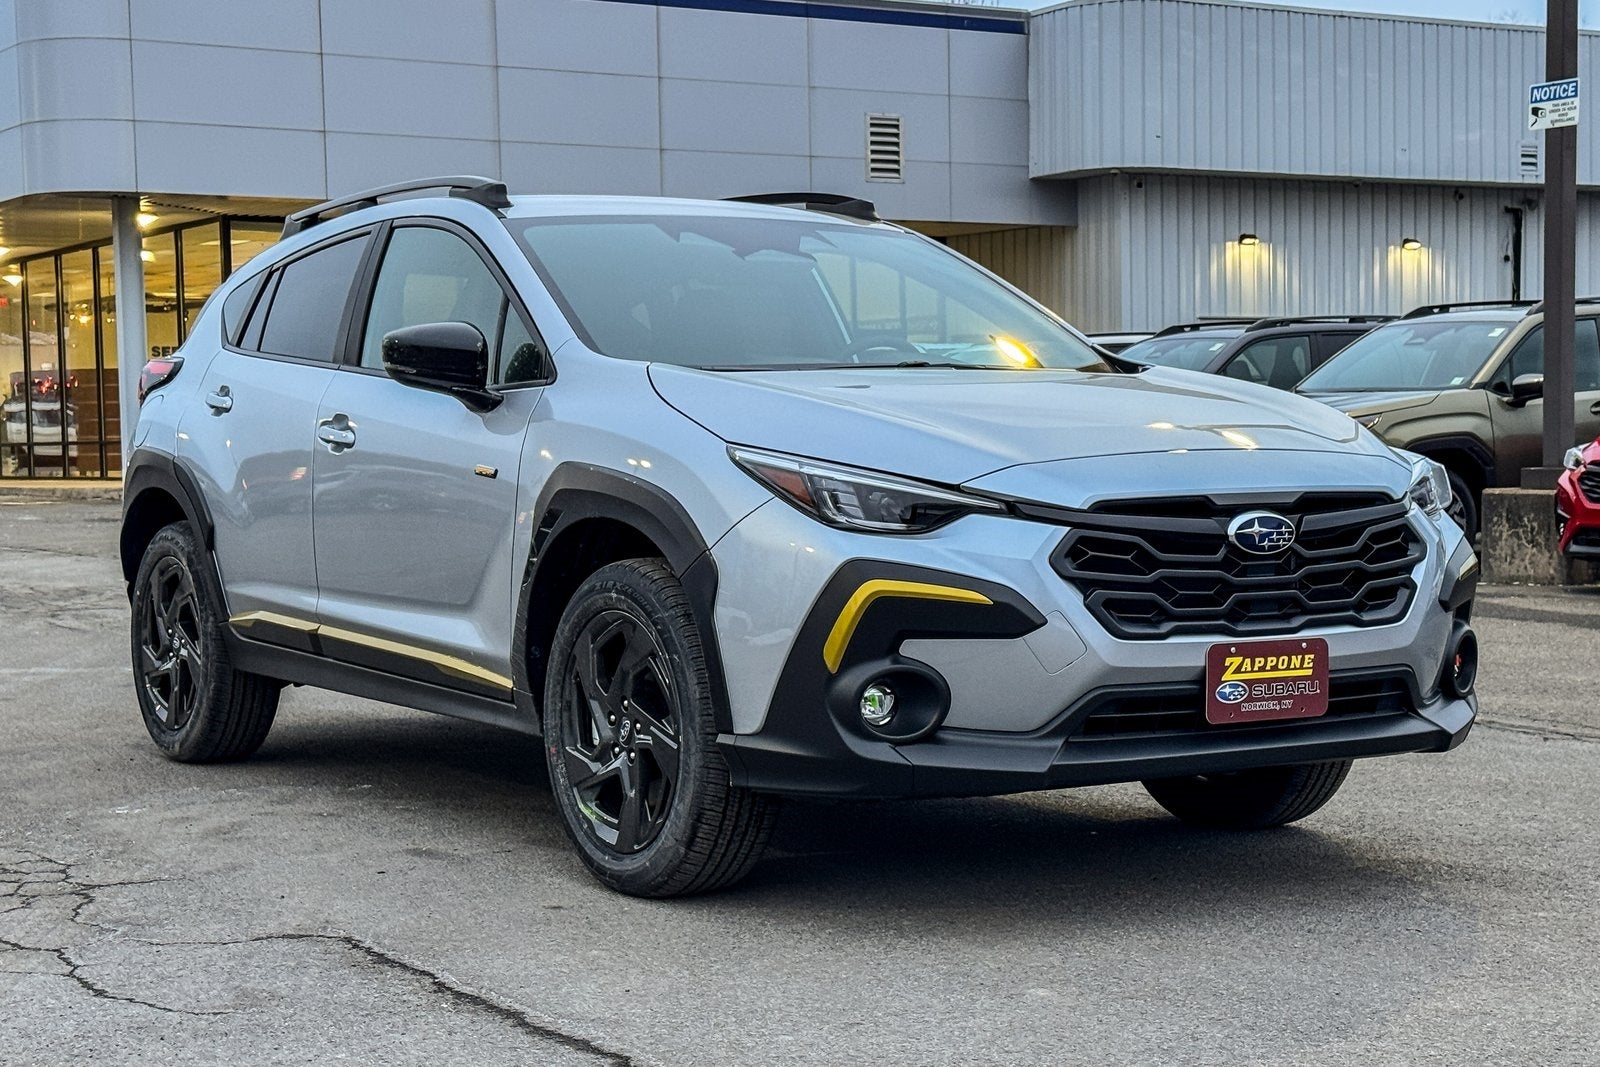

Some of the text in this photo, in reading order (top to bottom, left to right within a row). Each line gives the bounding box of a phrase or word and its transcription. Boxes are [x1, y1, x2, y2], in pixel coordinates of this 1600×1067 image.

[1532, 83, 1577, 102] NOTICE
[1221, 654, 1315, 681] ZAPPONE
[1252, 681, 1319, 698] SUBARU
[1241, 700, 1293, 711] NORWICH, NY
